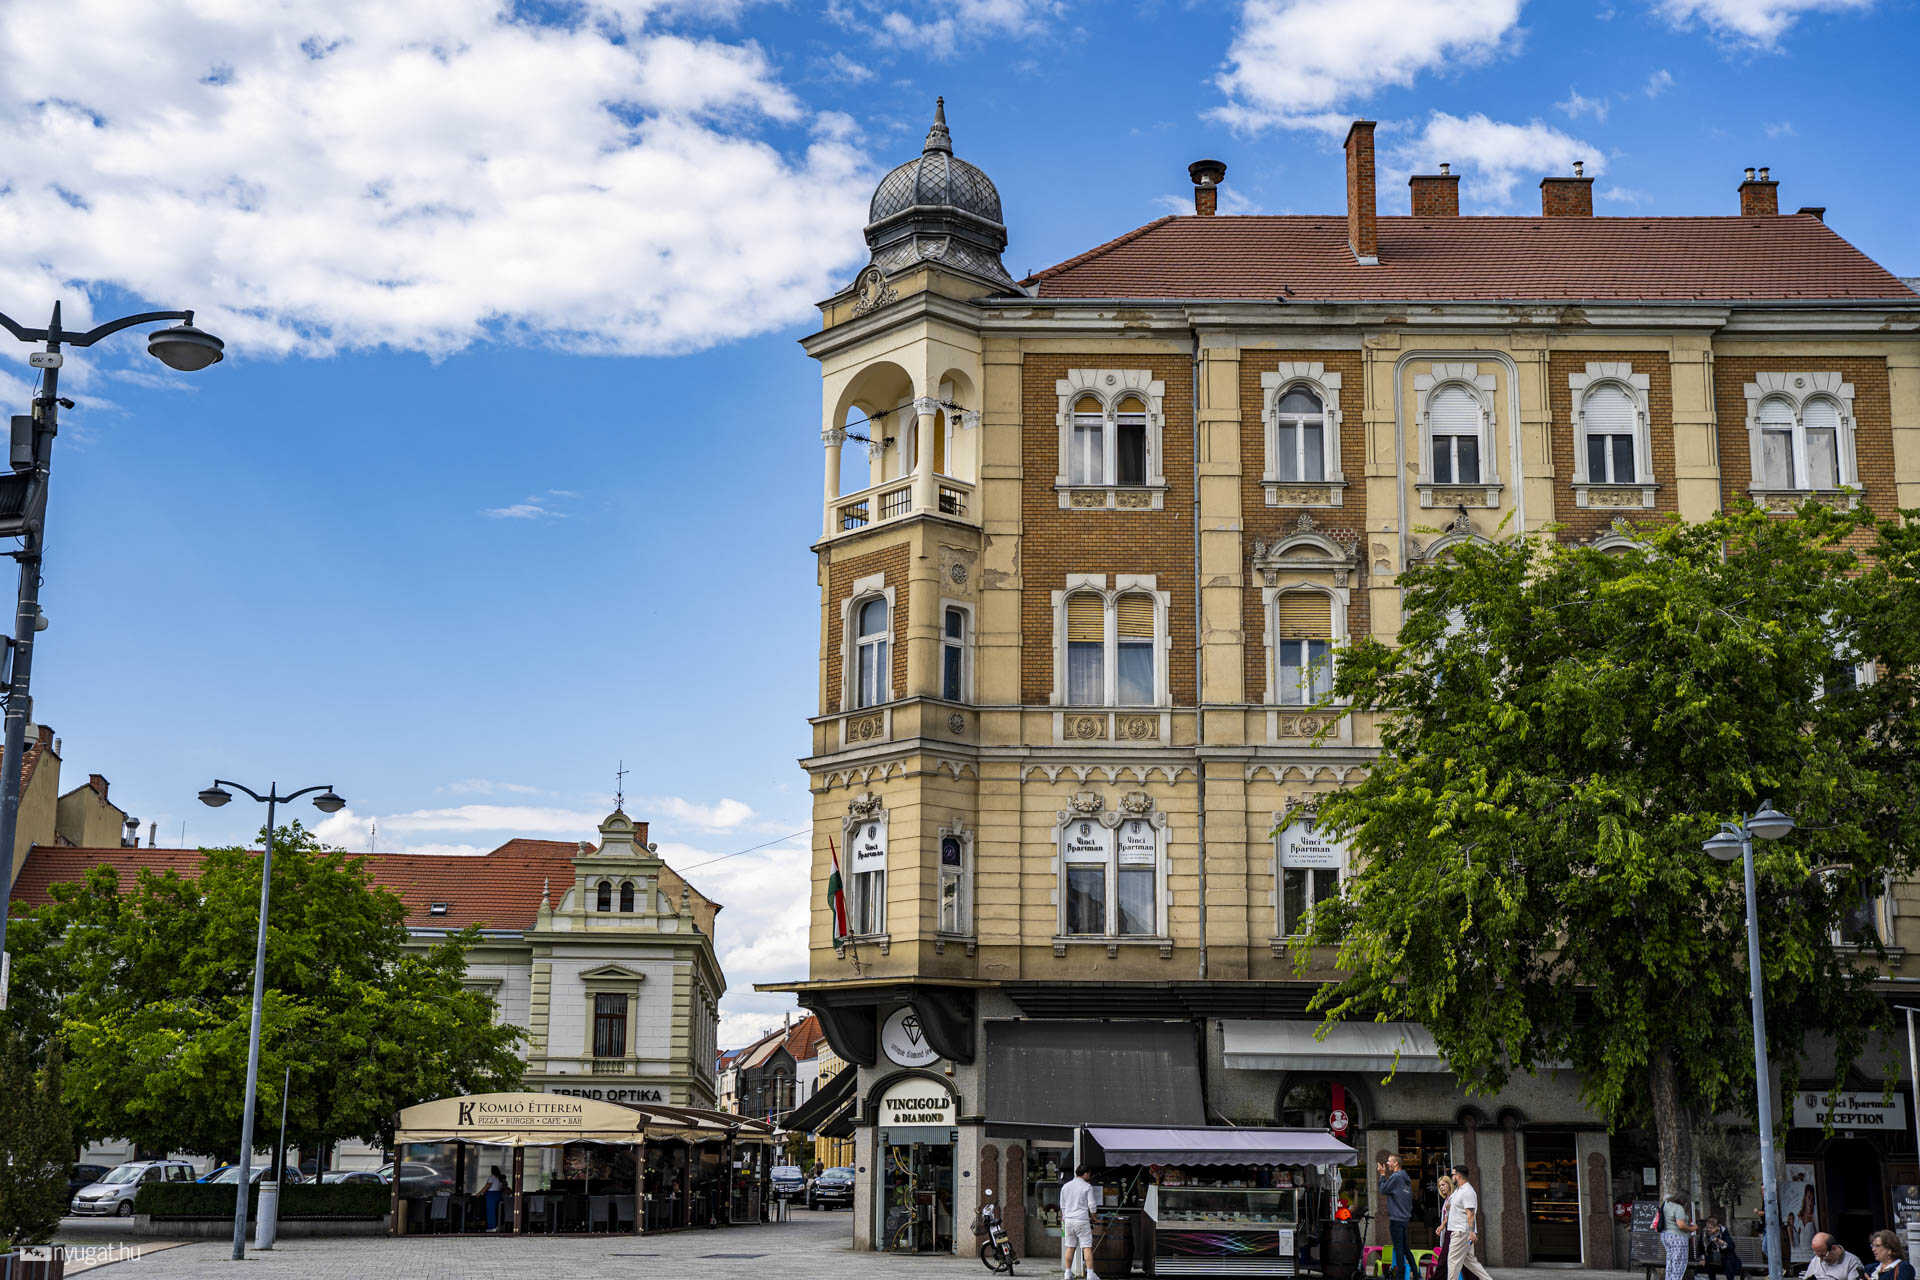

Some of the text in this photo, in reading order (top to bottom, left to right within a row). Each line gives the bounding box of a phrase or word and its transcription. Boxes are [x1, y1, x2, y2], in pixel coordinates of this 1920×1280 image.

[606, 1089, 662, 1102] OPTIKA
[886, 1097, 950, 1110] VINCIGOLD
[479, 1117, 499, 1125] PIZZA
[506, 1117, 535, 1125] BURGER
[568, 1117, 582, 1125] BAR
[894, 1113, 944, 1123] & DIAMOND
[1816, 1111, 1885, 1125] RCEPTION
